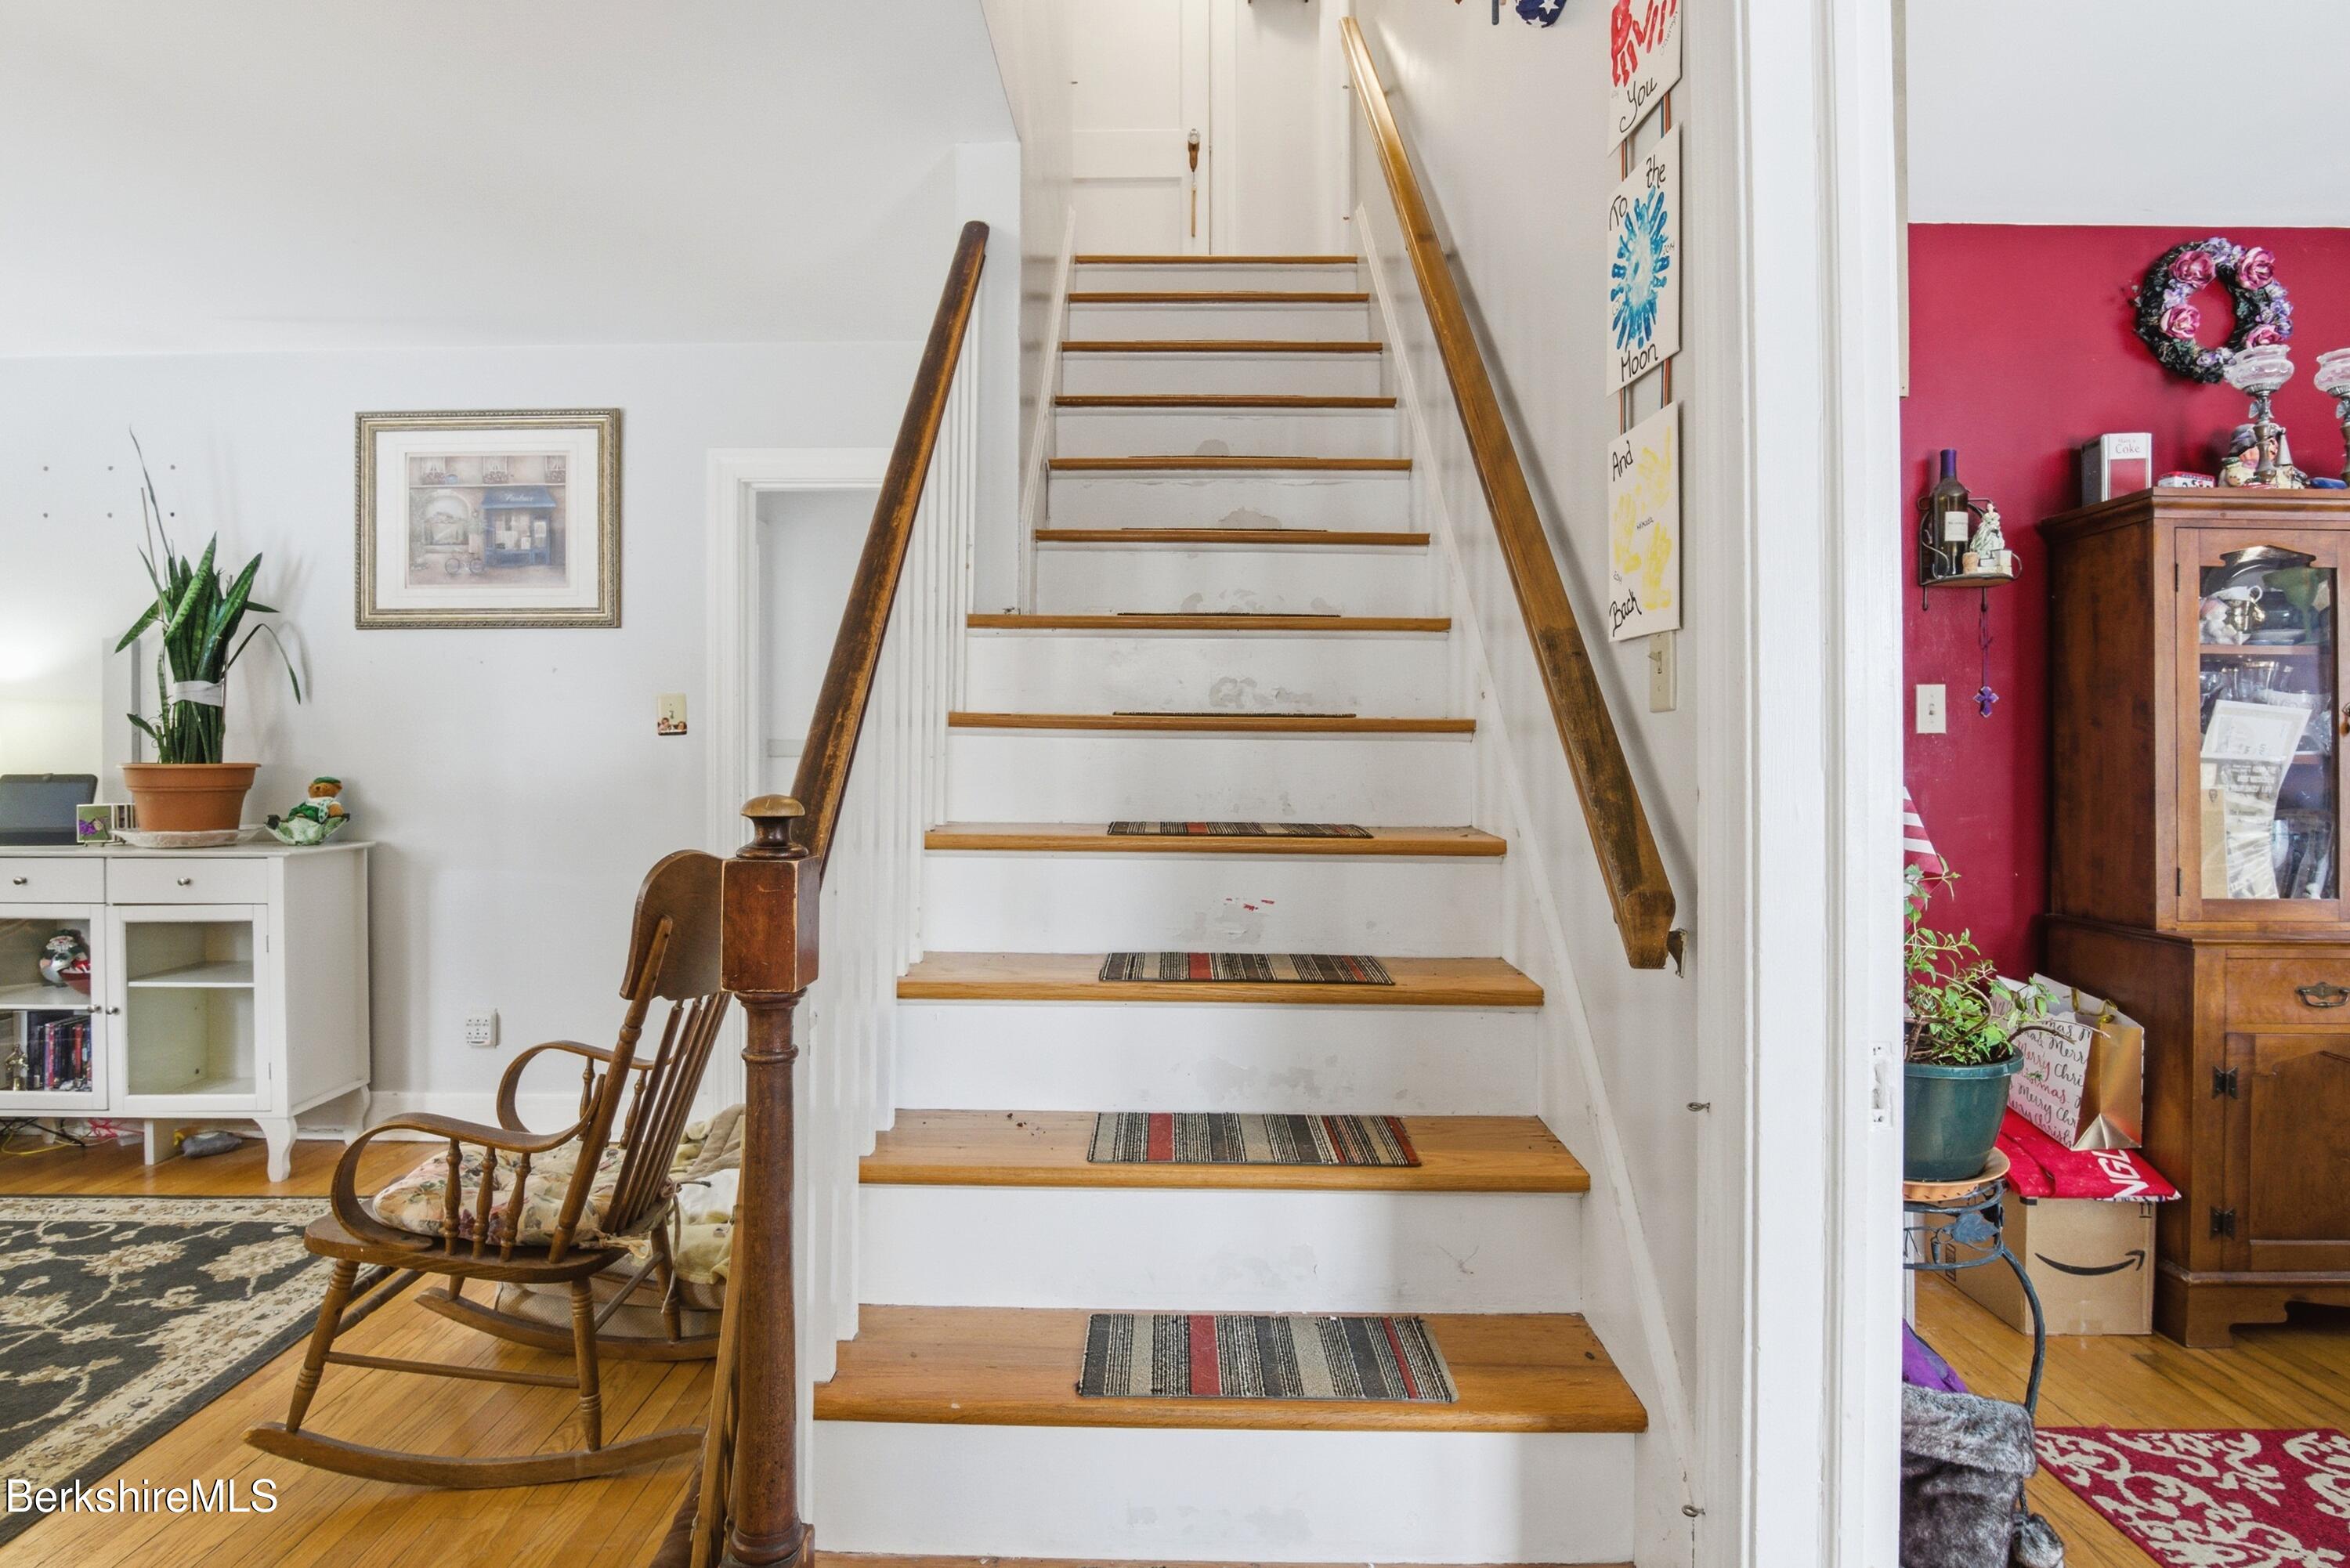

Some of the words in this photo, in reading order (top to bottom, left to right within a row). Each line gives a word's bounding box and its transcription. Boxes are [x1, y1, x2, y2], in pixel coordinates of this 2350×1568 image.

[1619, 77, 1658, 133] You
[1609, 194, 1628, 231] To
[1646, 154, 1666, 189] the
[1621, 343, 1658, 382] Moon
[1612, 439, 1633, 482] And
[2115, 443, 2141, 454] Coke
[1609, 588, 1643, 638] Back
